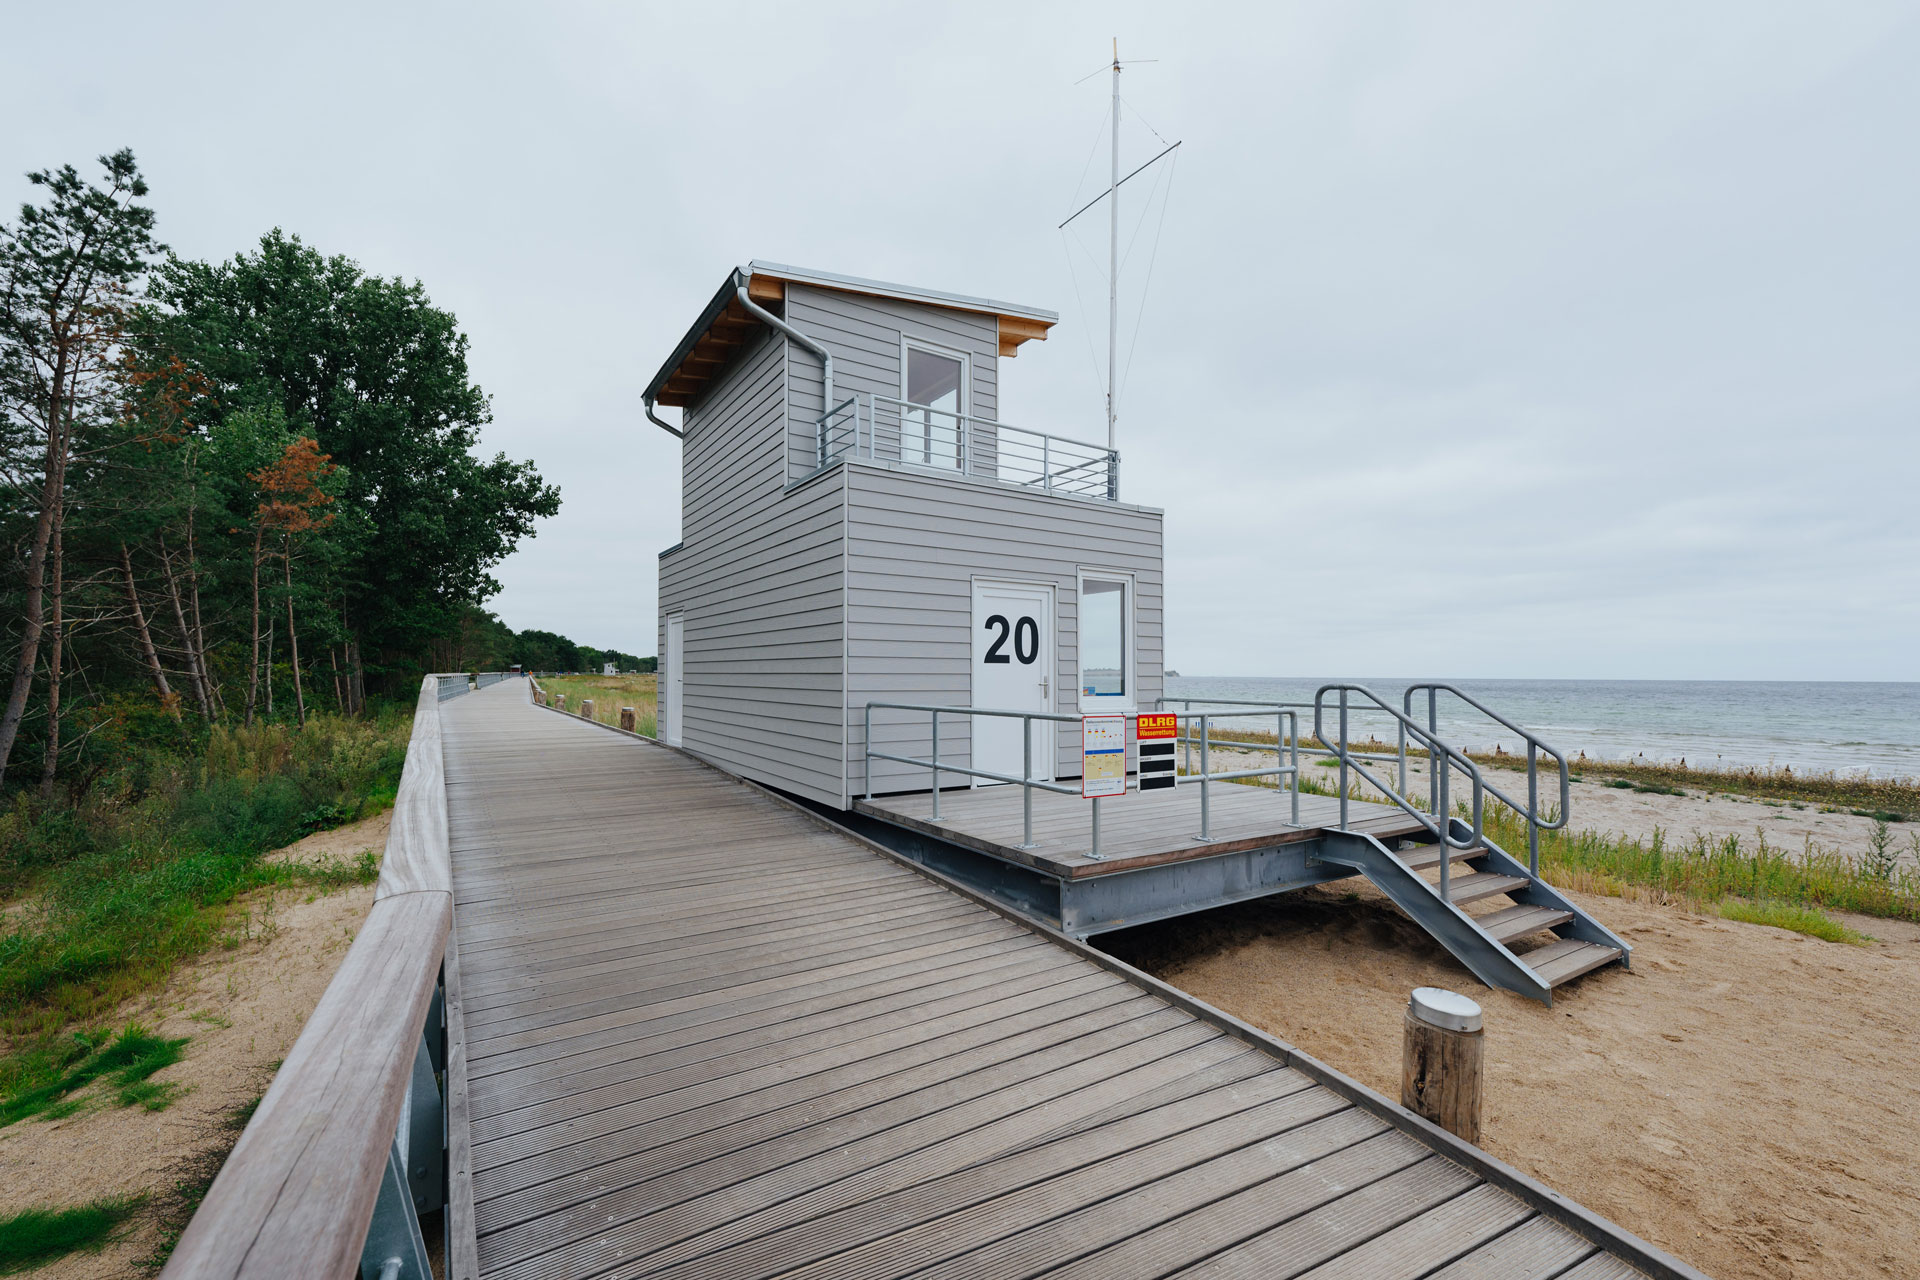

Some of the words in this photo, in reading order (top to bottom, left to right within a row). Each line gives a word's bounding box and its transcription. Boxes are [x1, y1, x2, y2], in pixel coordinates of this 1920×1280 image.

[984, 614, 1039, 665] 20
[1139, 717, 1175, 727] DLRG
[1139, 729, 1175, 737] Wasserrettung
